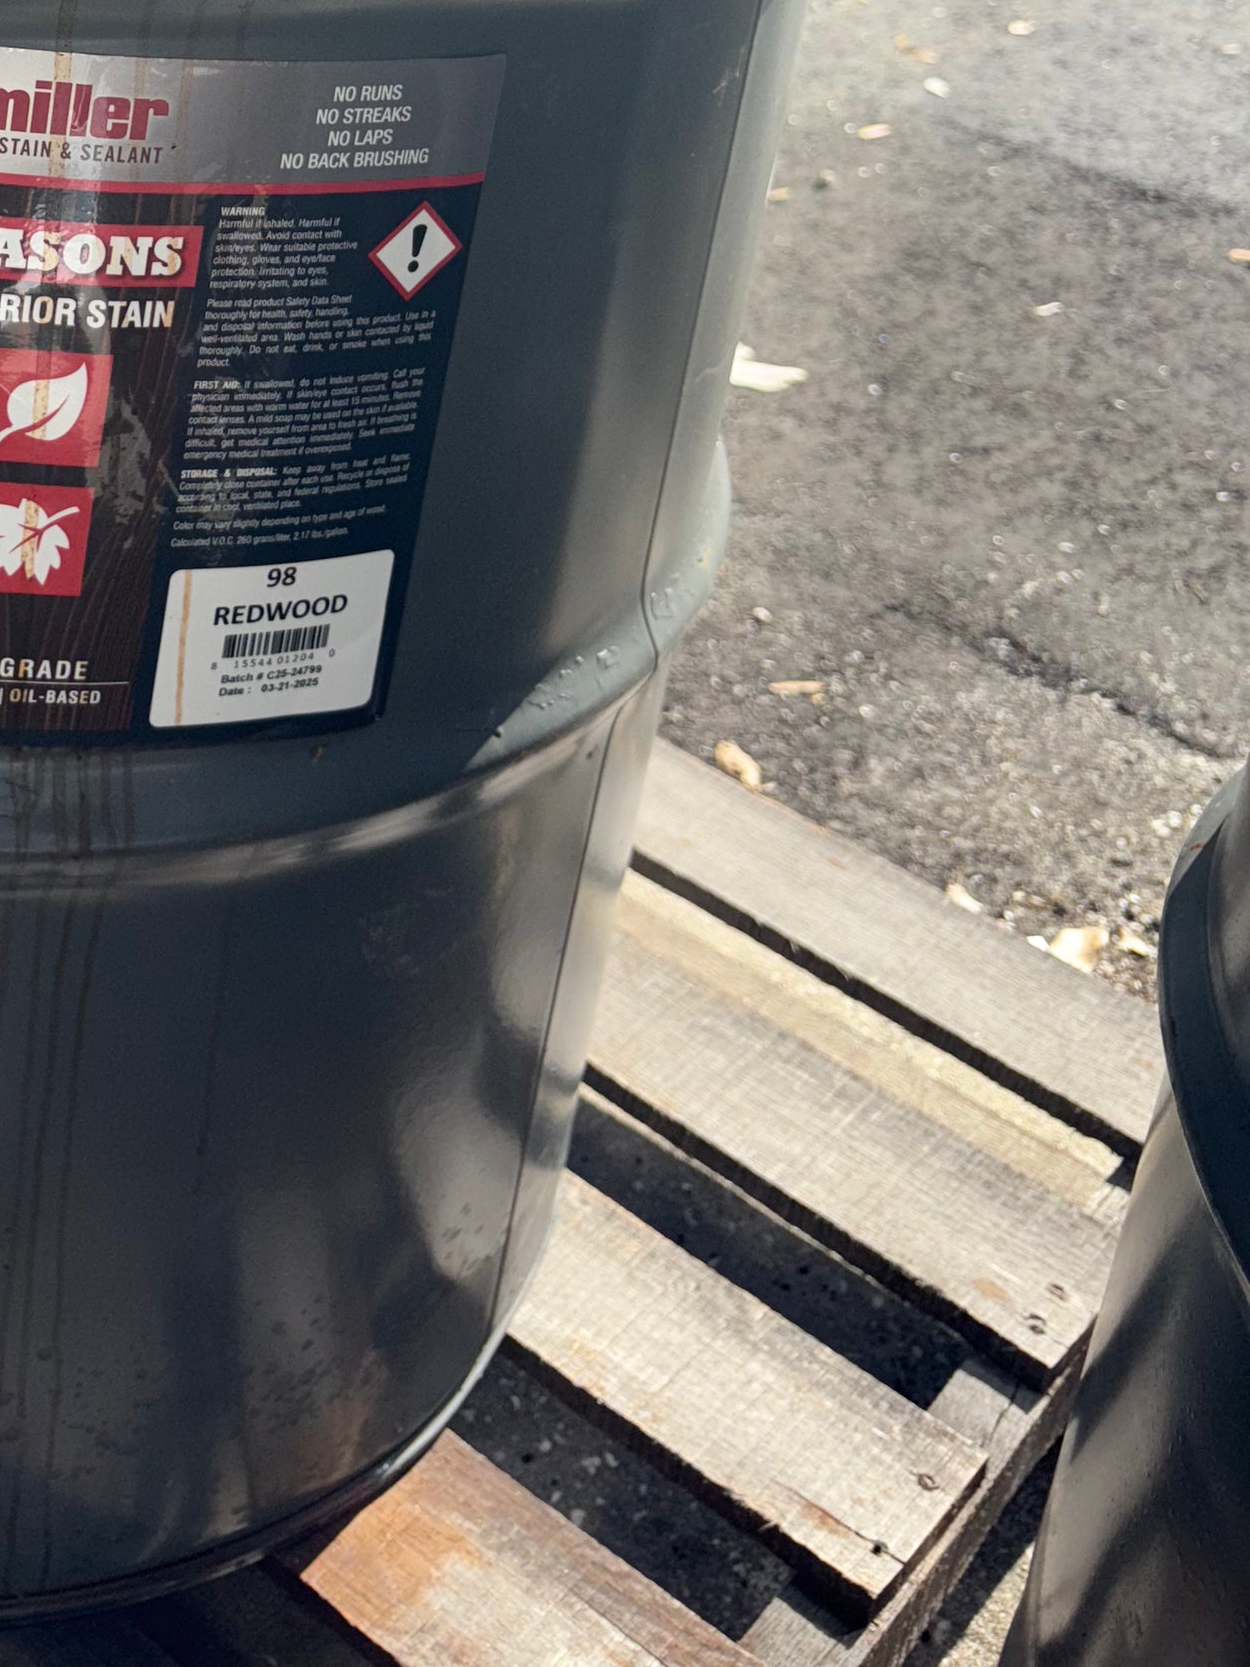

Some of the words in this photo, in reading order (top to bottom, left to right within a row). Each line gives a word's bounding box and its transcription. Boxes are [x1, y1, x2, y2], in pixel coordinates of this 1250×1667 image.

[333, 86, 355, 102] NO
[360, 85, 403, 101] RUNS
[316, 109, 338, 124] NO
[343, 106, 412, 124] STREAKS
[328, 131, 350, 146] NO
[354, 129, 393, 145] LAPS
[60, 144, 72, 160] &
[80, 144, 163, 164] SEALANT
[280, 153, 303, 169] NO
[308, 152, 350, 168] BACK
[353, 148, 429, 167] BRUSHING
[221, 207, 265, 216] WARNING
[219, 219, 253, 228] Harmful
[299, 218, 332, 227] Harmful
[334, 217, 340, 226] if
[266, 231, 290, 239] Avoid
[292, 231, 323, 239] contact
[325, 230, 342, 238] with
[260, 243, 280, 251] Wear
[283, 242, 316, 251] suitable
[318, 241, 358, 251] protective
[284, 255, 299, 263] and
[297, 267, 305, 275] to
[86, 299, 175, 328] STAIN
[267, 567, 297, 587] 98
[214, 594, 347, 626] REDWOOD
[0, 658, 88, 680] GRADE
[211, 662, 217, 670] 8
[234, 657, 273, 668] 15544
[221, 672, 253, 684] Batch
[256, 672, 263, 681] #
[10, 689, 101, 705] OIL-BASED
[219, 687, 244, 696] Date
